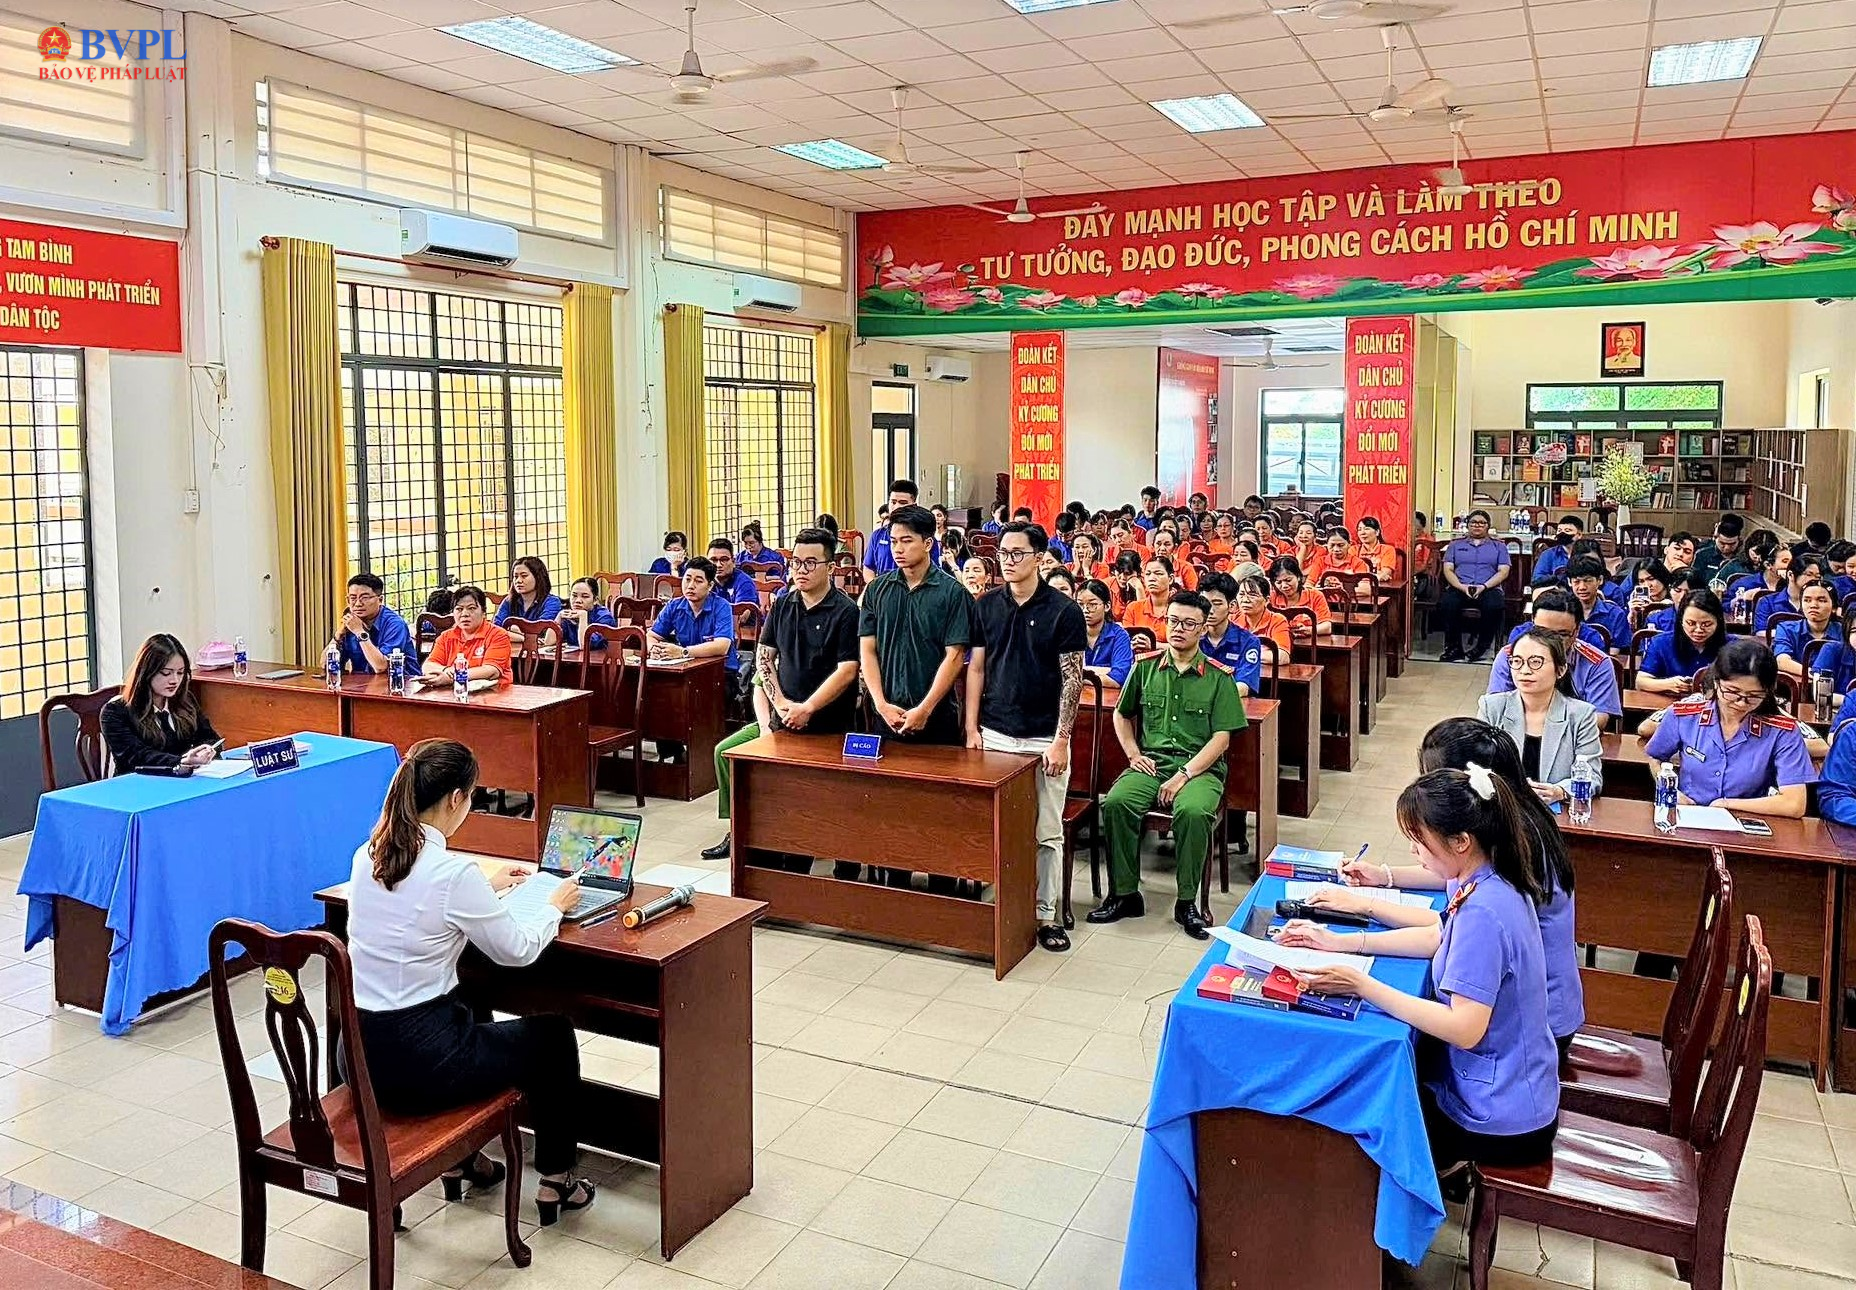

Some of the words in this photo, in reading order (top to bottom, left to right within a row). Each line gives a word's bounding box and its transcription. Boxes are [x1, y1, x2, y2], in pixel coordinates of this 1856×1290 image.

[1125, 205, 1202, 239] MẠNH
[1213, 200, 1270, 232] HỌC
[1279, 190, 1337, 228] TẬP
[1346, 184, 1385, 218] VÀ
[1397, 180, 1462, 215] LÀM
[1473, 178, 1562, 210] THEO
[5, 237, 36, 261] TAM
[39, 238, 73, 265] BÌNH
[980, 251, 1014, 280] TƯ
[1020, 243, 1112, 277] TƯỞNG,
[1121, 244, 1176, 275] ĐẠO
[1184, 234, 1250, 269] ĐỨC,
[1261, 231, 1361, 262] PHONG
[1370, 221, 1452, 255] CÁCH
[1465, 210, 1509, 250] HỒ
[1520, 209, 1579, 246] CHÍ
[1589, 210, 1680, 243] MINH
[5, 271, 45, 295] VƯƠN
[48, 273, 85, 299] MÌNH
[88, 278, 121, 302] PHÁT
[124, 279, 160, 306] TRIỂN
[0, 302, 30, 328] DÂN
[33, 305, 60, 333] TỘC
[1018, 343, 1040, 365] ĐOÀN
[1042, 340, 1057, 364] KẾT
[1354, 330, 1383, 354] ĐOÀN
[1385, 328, 1405, 354] KẾT
[1021, 372, 1038, 394] DÂN
[1040, 370, 1057, 394] CHỦ
[1358, 364, 1380, 387] DÂN
[1383, 360, 1404, 387] CHỦ
[1030, 403, 1059, 423] CƯƠNG
[1354, 394, 1368, 419] KỶ
[1370, 399, 1406, 419] CƯƠNG
[1358, 425, 1375, 452] ĐỔI
[1378, 428, 1398, 452] MỚI
[1014, 459, 1035, 480] PHÁT
[1349, 461, 1375, 484] PHÁT
[1377, 457, 1407, 484] TRIỂN
[255, 752, 280, 768] LUẬT
[282, 749, 295, 762] SƯ
